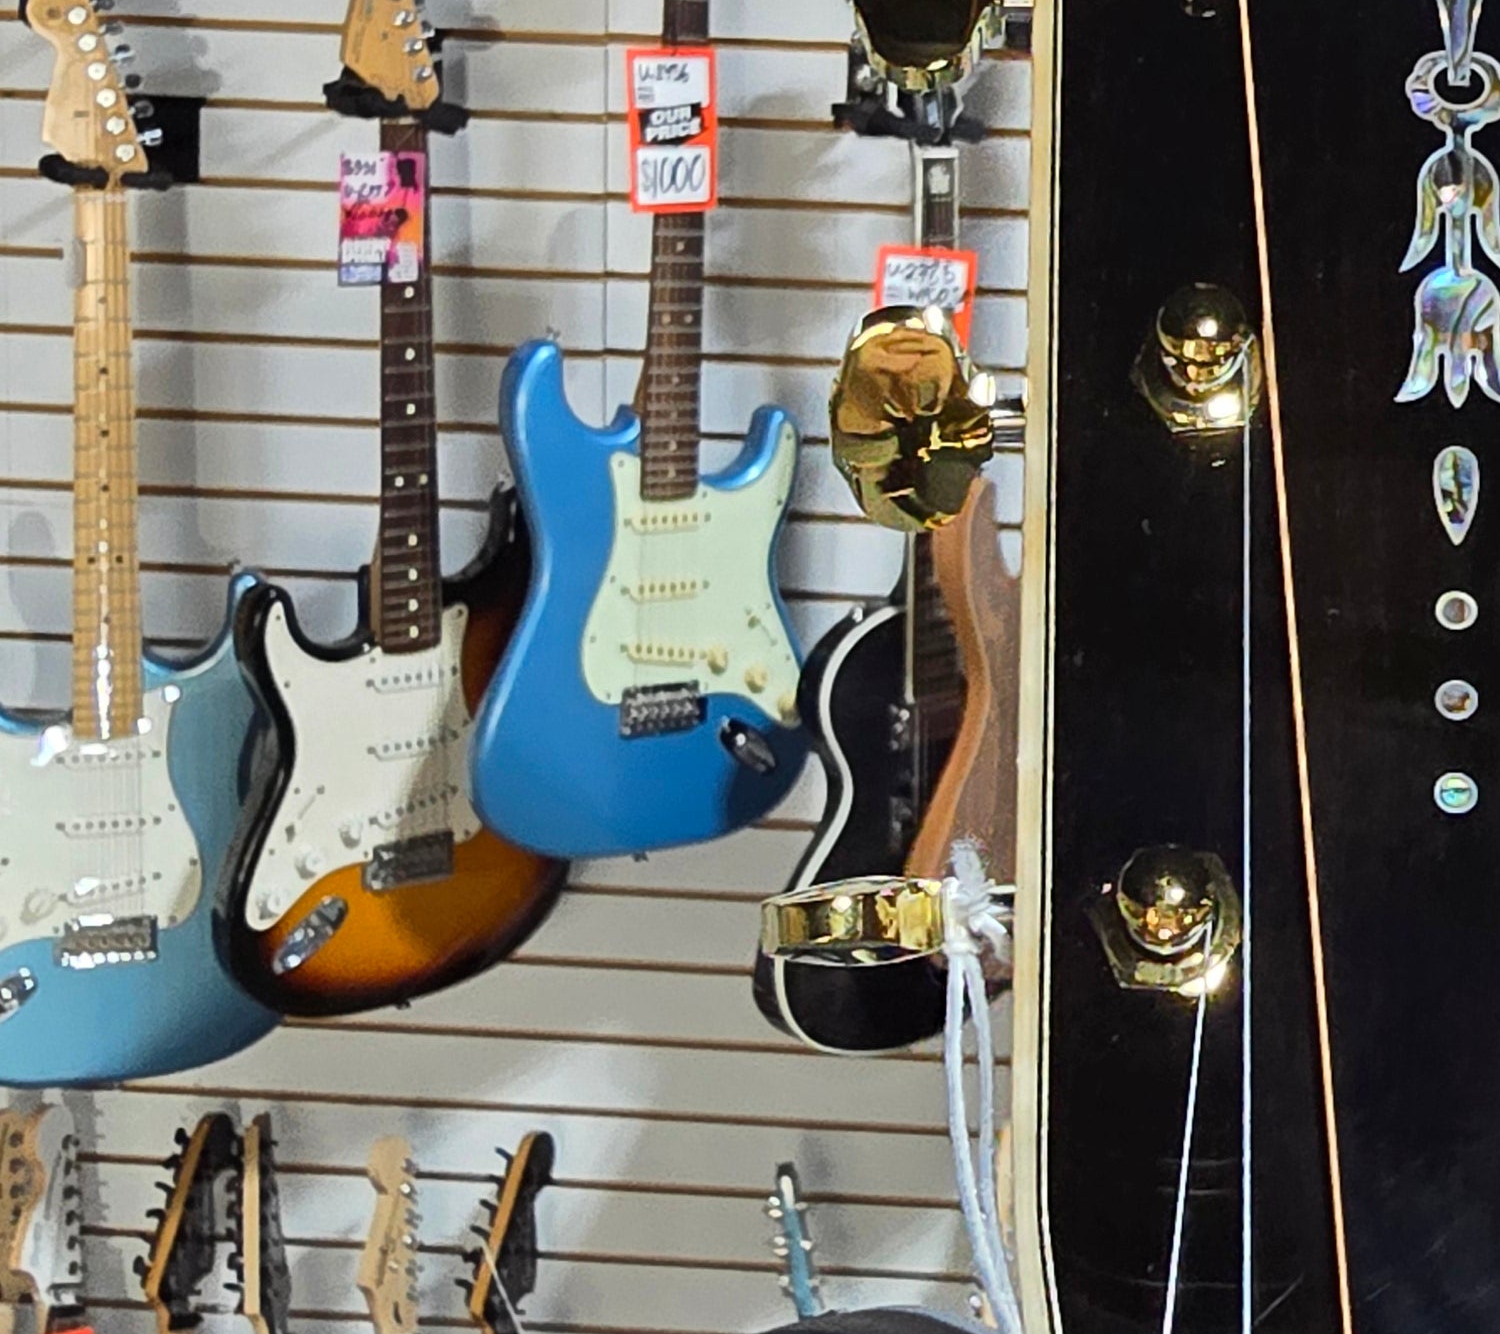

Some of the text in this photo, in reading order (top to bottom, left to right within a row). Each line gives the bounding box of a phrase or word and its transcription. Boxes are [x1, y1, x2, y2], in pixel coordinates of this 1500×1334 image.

[650, 105, 692, 126] OUR
[644, 118, 702, 143] PRICE
[641, 153, 706, 199] $1000
